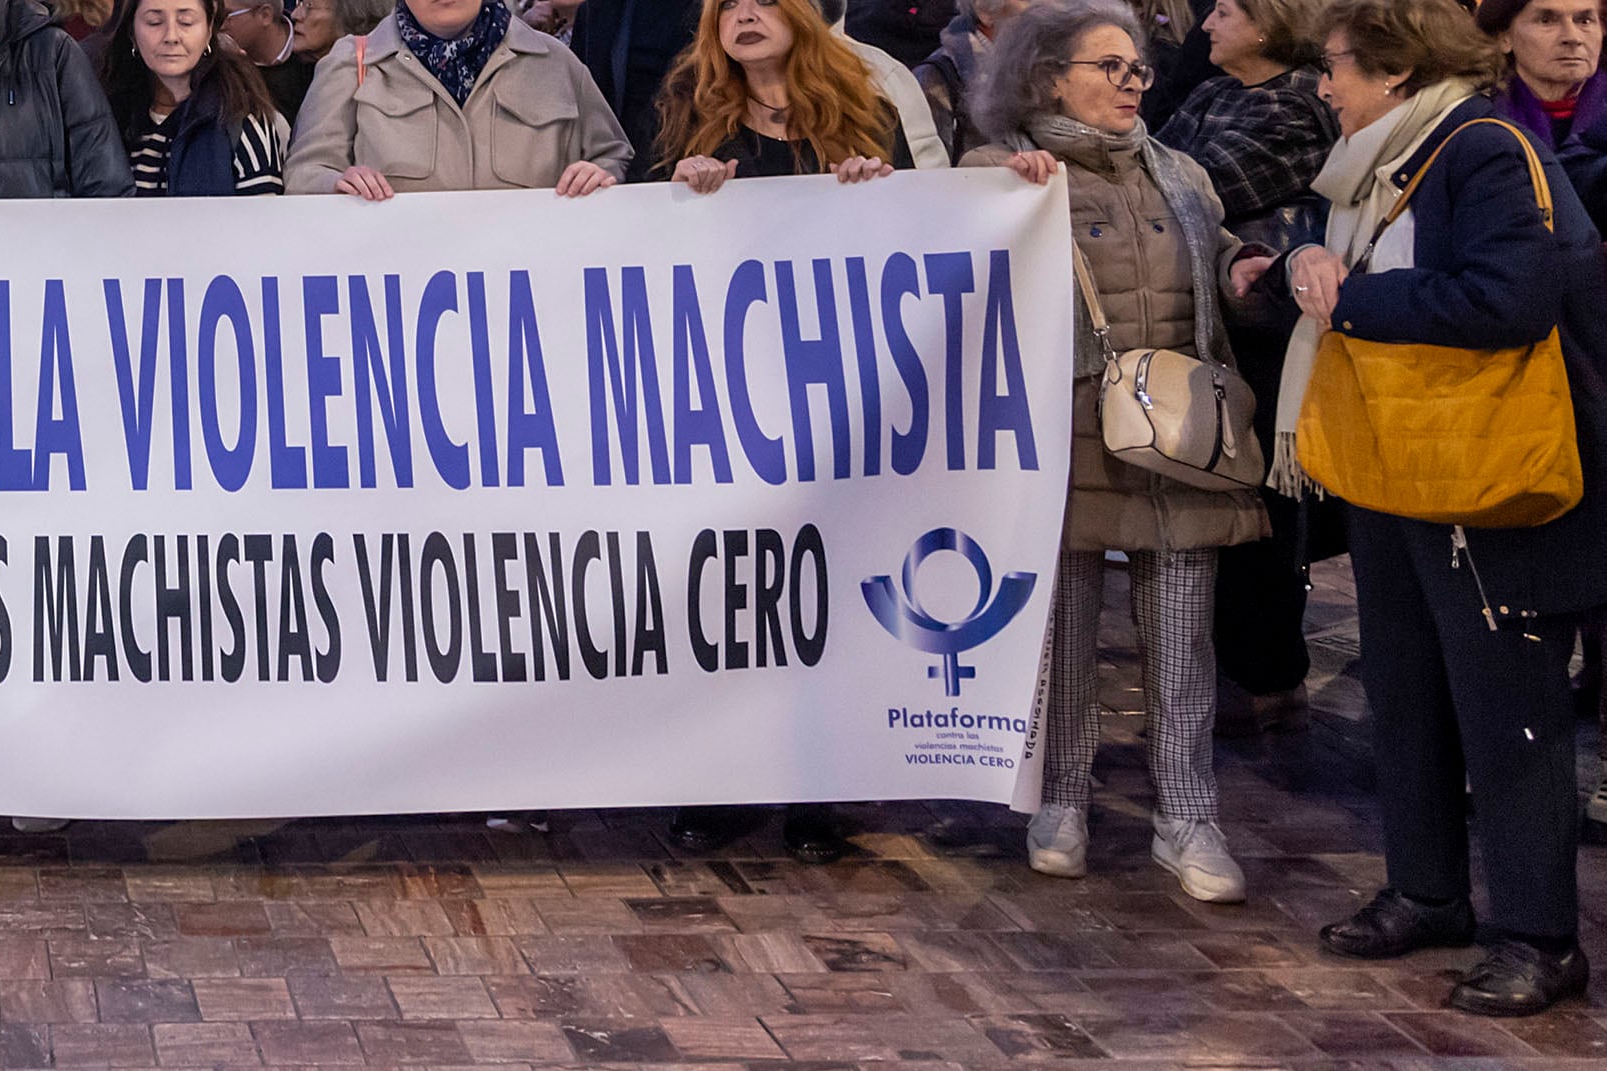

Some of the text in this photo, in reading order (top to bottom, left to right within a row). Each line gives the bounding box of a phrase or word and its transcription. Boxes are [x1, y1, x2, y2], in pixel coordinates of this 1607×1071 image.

[102, 269, 565, 493] VIOLENCIA
[583, 248, 1040, 486] MACHISTA
[32, 531, 342, 685] MACHISTAS
[352, 529, 669, 685] VIOLENCIA
[687, 522, 830, 674] CERO
[887, 706, 1028, 734] Plataforma
[936, 730, 980, 740] contra las
[914, 740, 1004, 754] violencias machistas
[905, 753, 1015, 770] VIOLENCIA CERO
